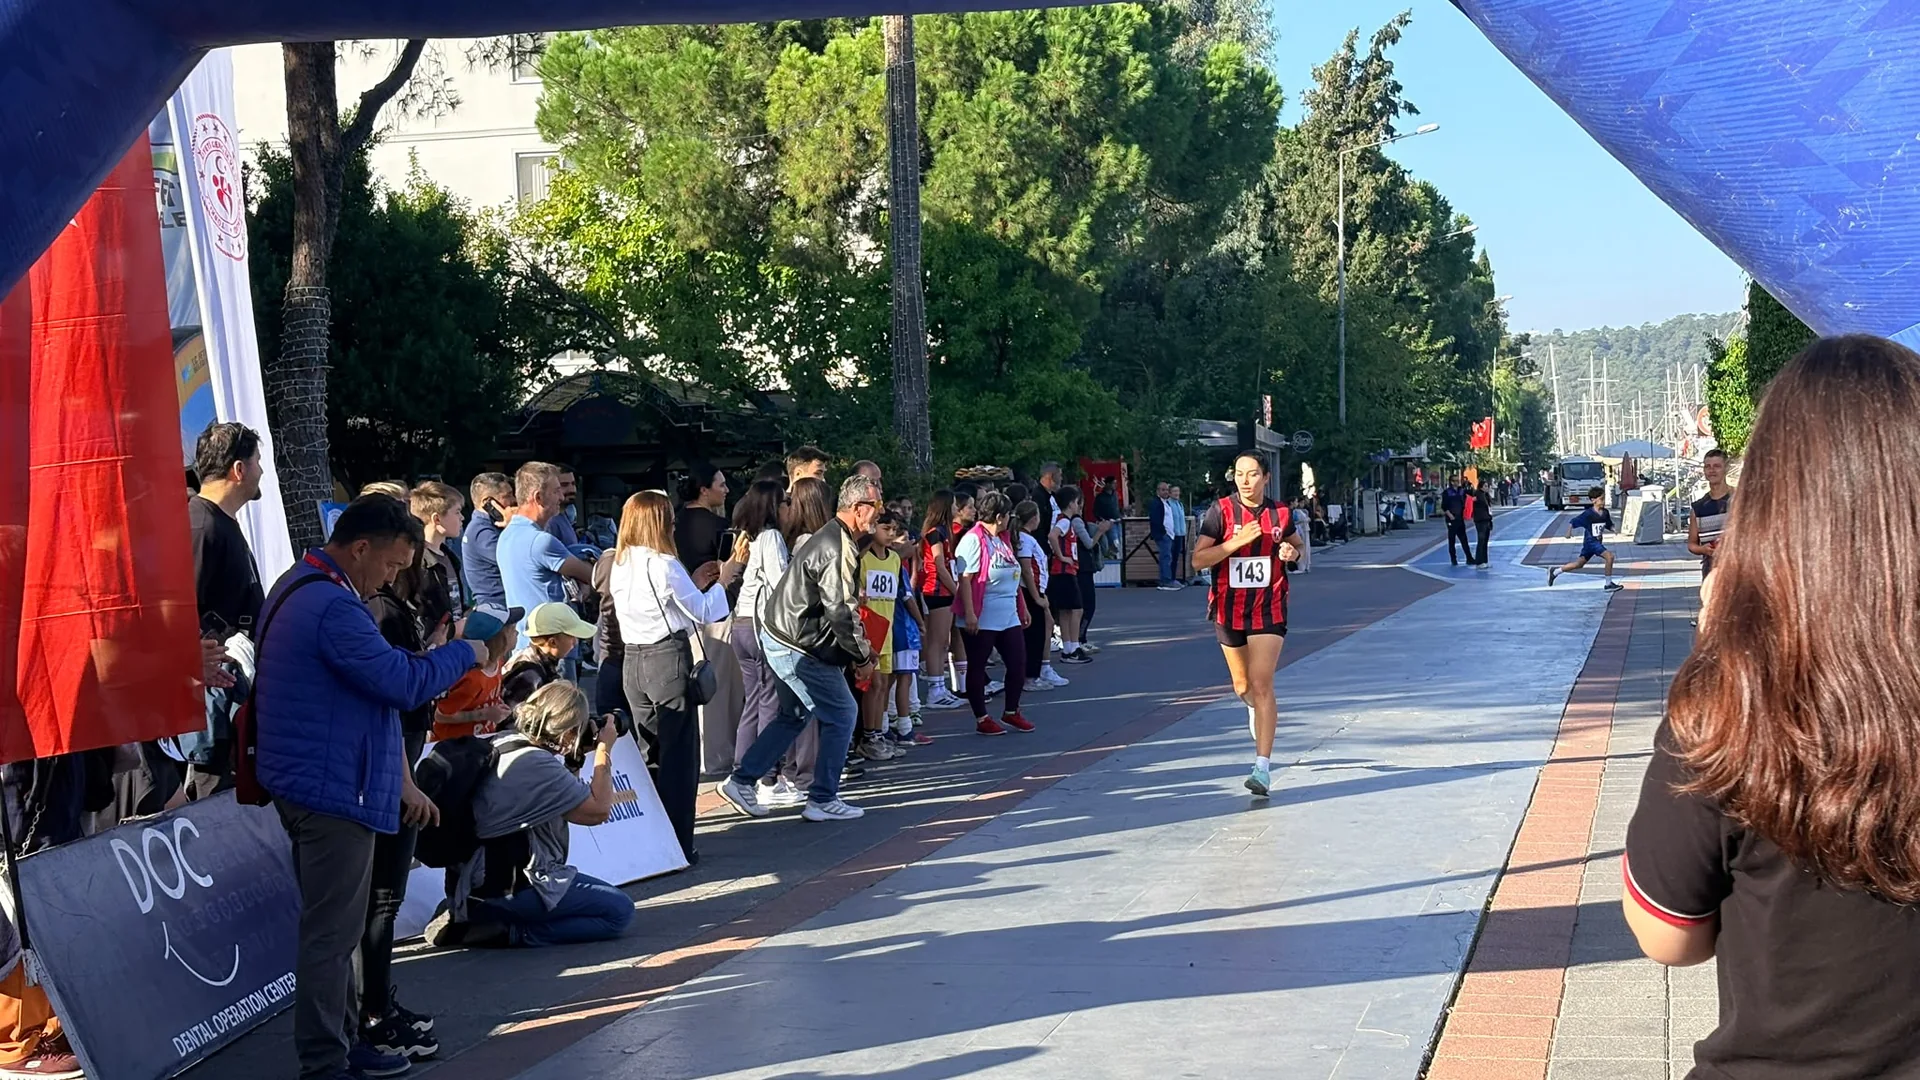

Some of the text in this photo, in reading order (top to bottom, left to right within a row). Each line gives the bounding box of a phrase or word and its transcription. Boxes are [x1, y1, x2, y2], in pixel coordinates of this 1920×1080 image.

[871, 574, 893, 594] 481
[1235, 562, 1264, 583] 143
[110, 817, 214, 914] DOC
[172, 1020, 218, 1057] DENTAL
[211, 989, 270, 1034] OPERATION
